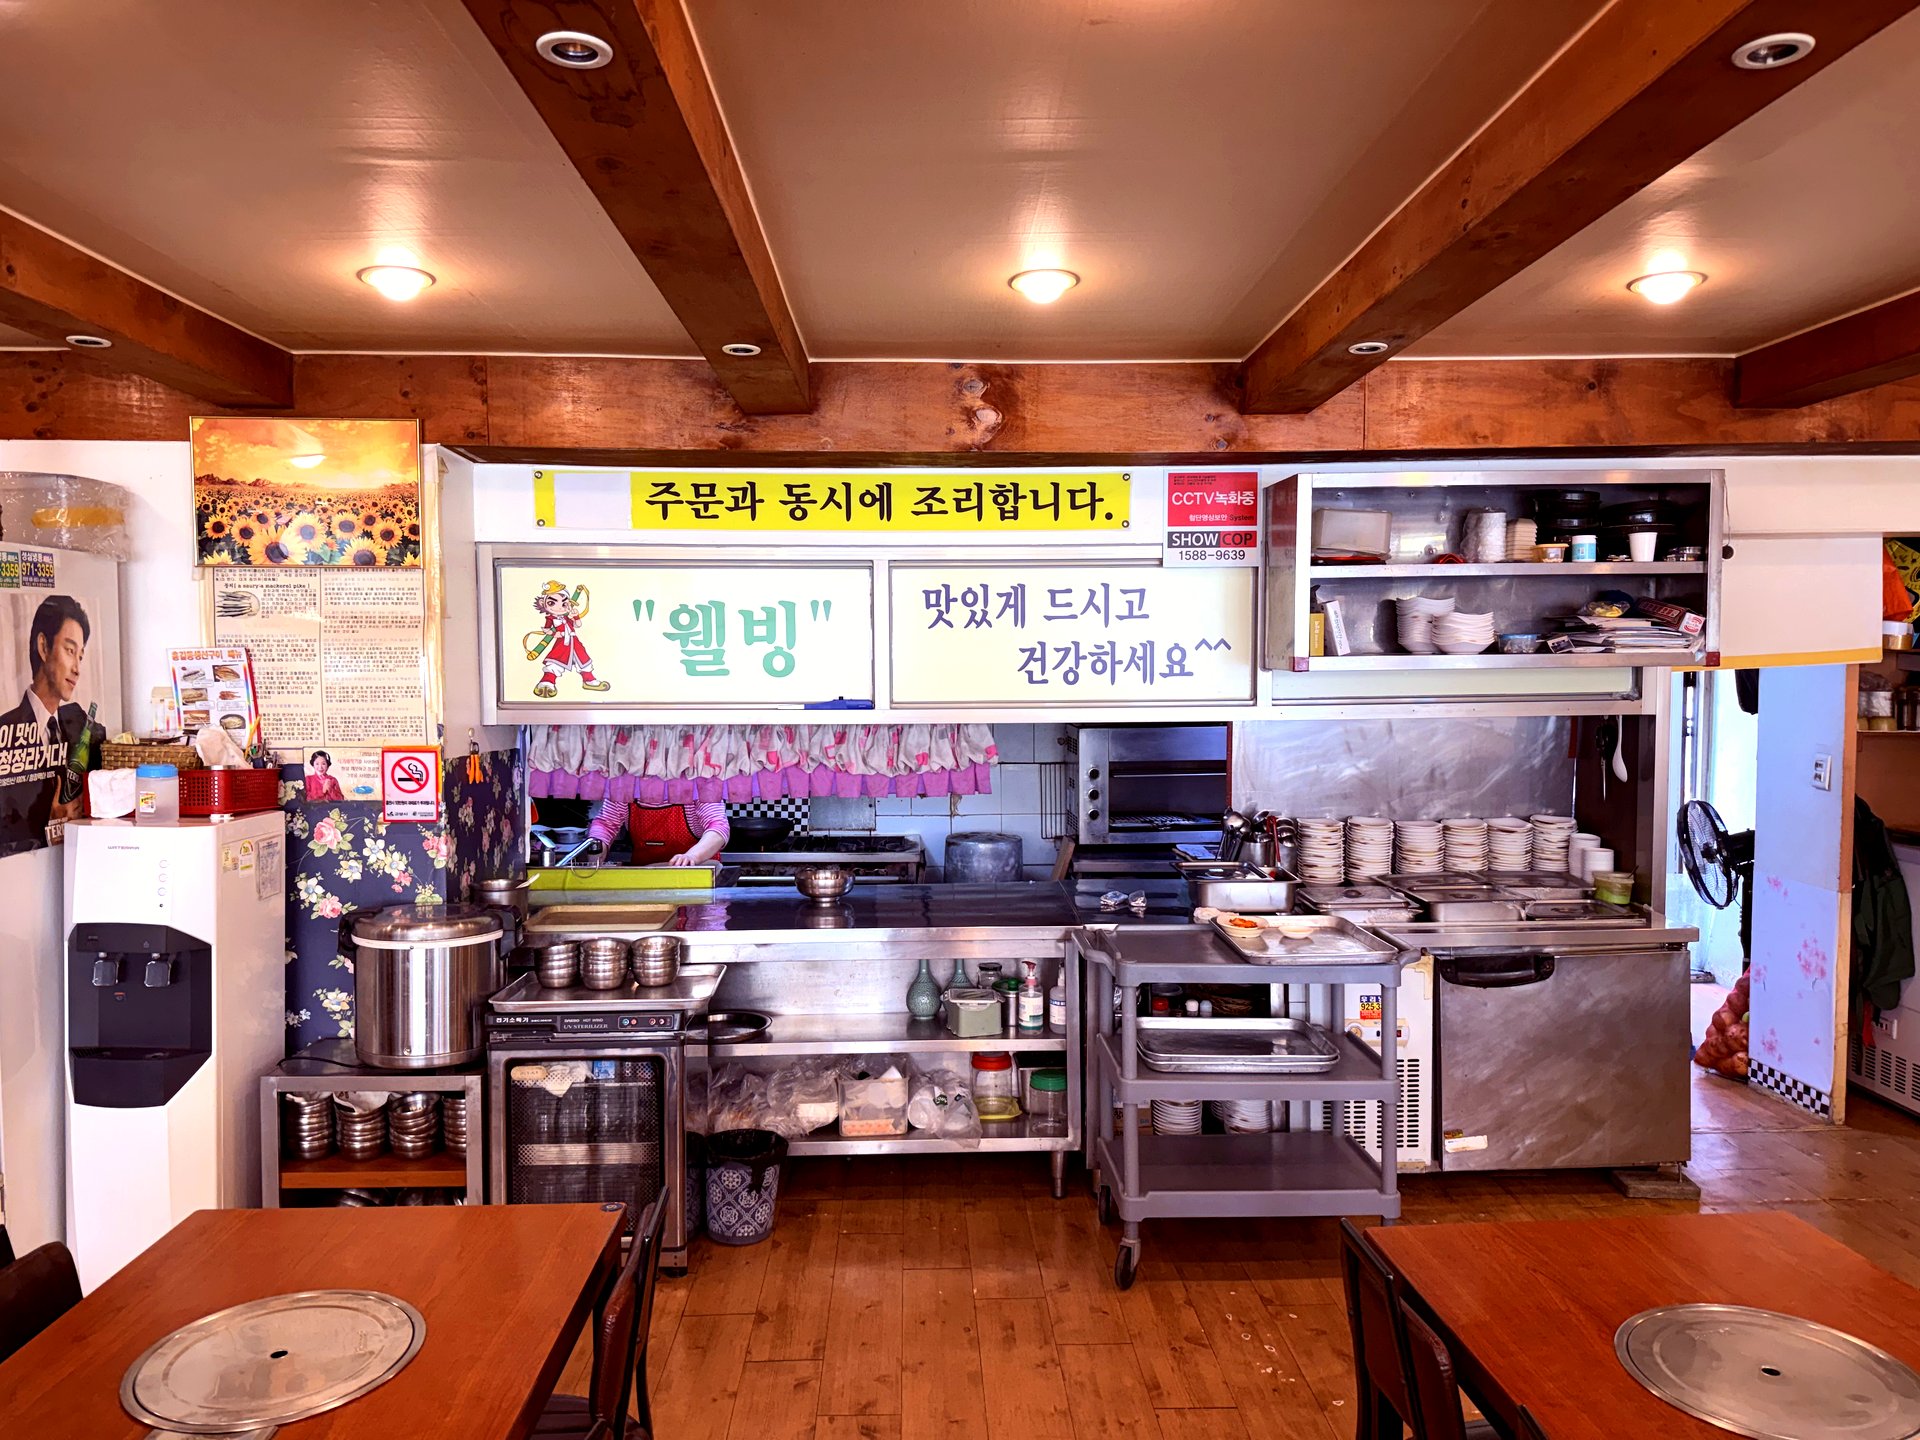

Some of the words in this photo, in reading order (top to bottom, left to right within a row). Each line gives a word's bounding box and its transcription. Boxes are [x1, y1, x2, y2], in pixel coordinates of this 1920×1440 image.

[645, 481, 764, 522] 주문과
[778, 481, 892, 522] 동시에
[910, 481, 1114, 522] 조리합니다.
[1171, 490, 1256, 506] CCTV녹화중
[1171, 533, 1219, 546] SHOW
[1221, 533, 1253, 546] COP
[1178, 550, 1246, 561] 1588-9639
[22, 562, 54, 577] 971-3359
[922, 583, 1026, 629] 맛있게
[1043, 583, 1150, 628] 드시고
[14, 722, 40, 747] 맛이
